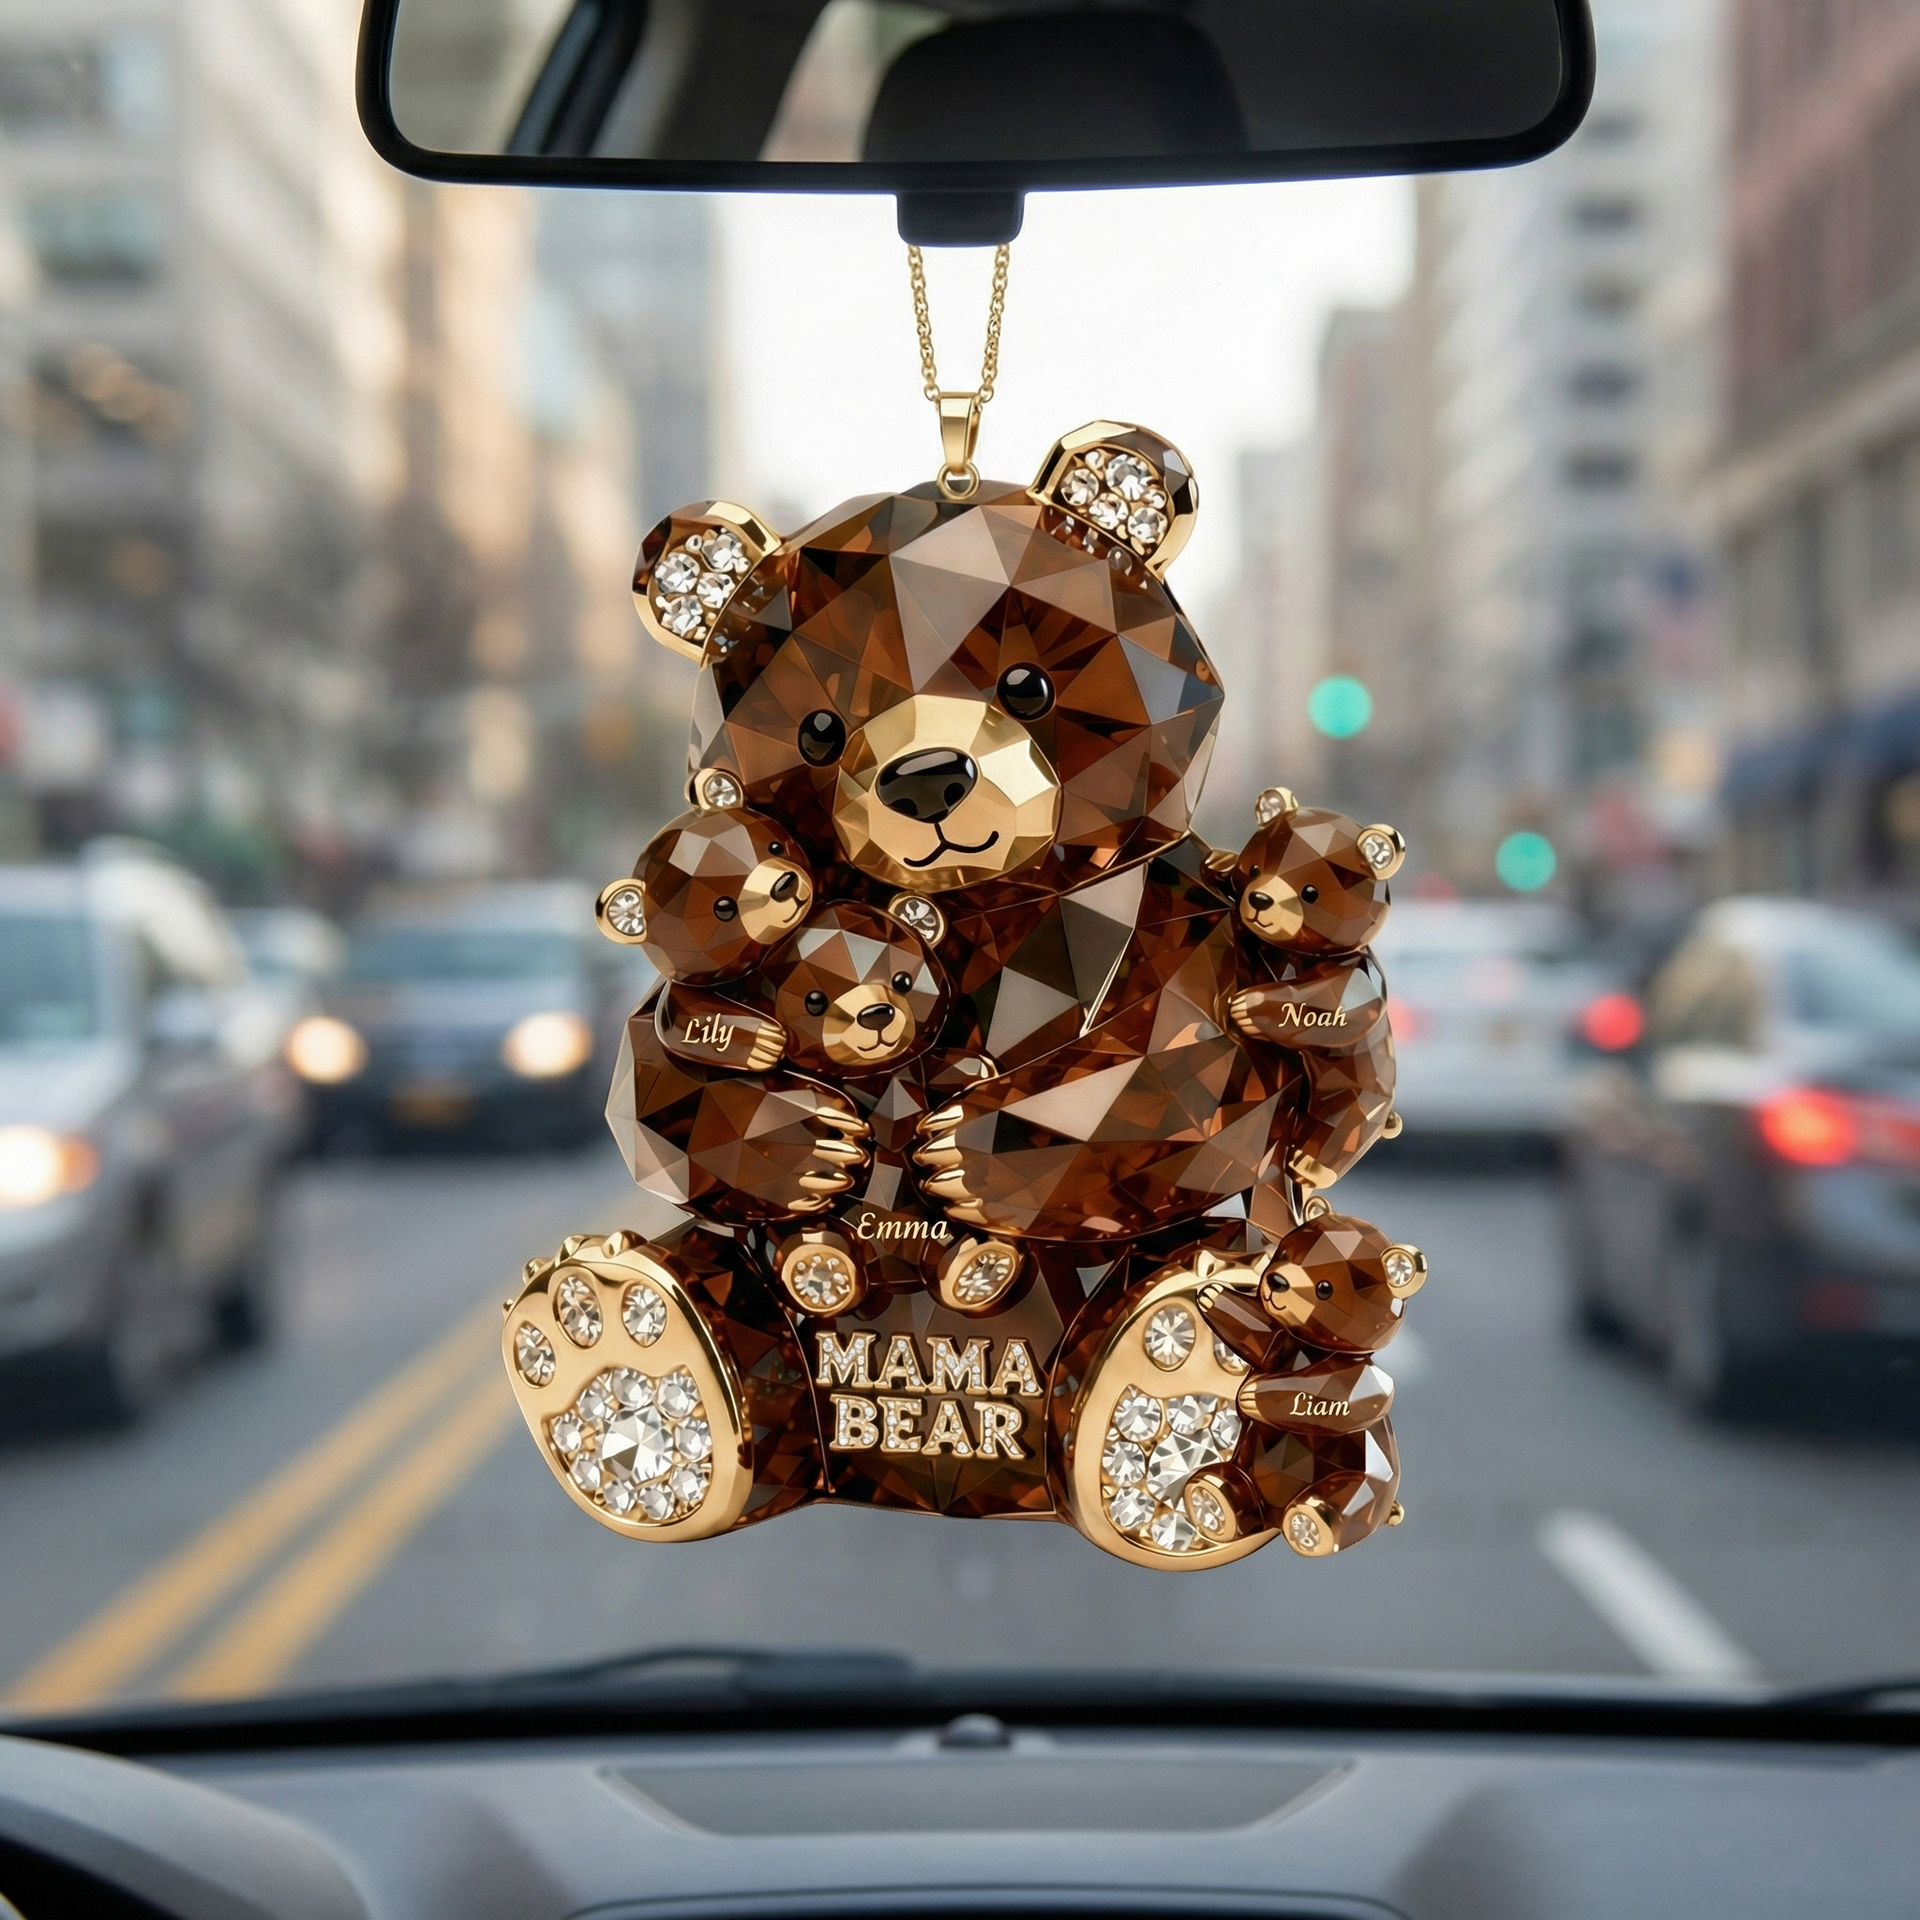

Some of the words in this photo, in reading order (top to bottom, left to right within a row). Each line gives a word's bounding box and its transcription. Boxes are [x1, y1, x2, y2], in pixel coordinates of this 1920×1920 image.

[1278, 1003, 1348, 1028] Noah
[681, 1013, 735, 1053] Lily
[856, 1212, 949, 1240] Emma
[815, 1332, 1044, 1397] MAMA
[1289, 1391, 1350, 1416] Liam
[829, 1393, 1027, 1461] BEAR
